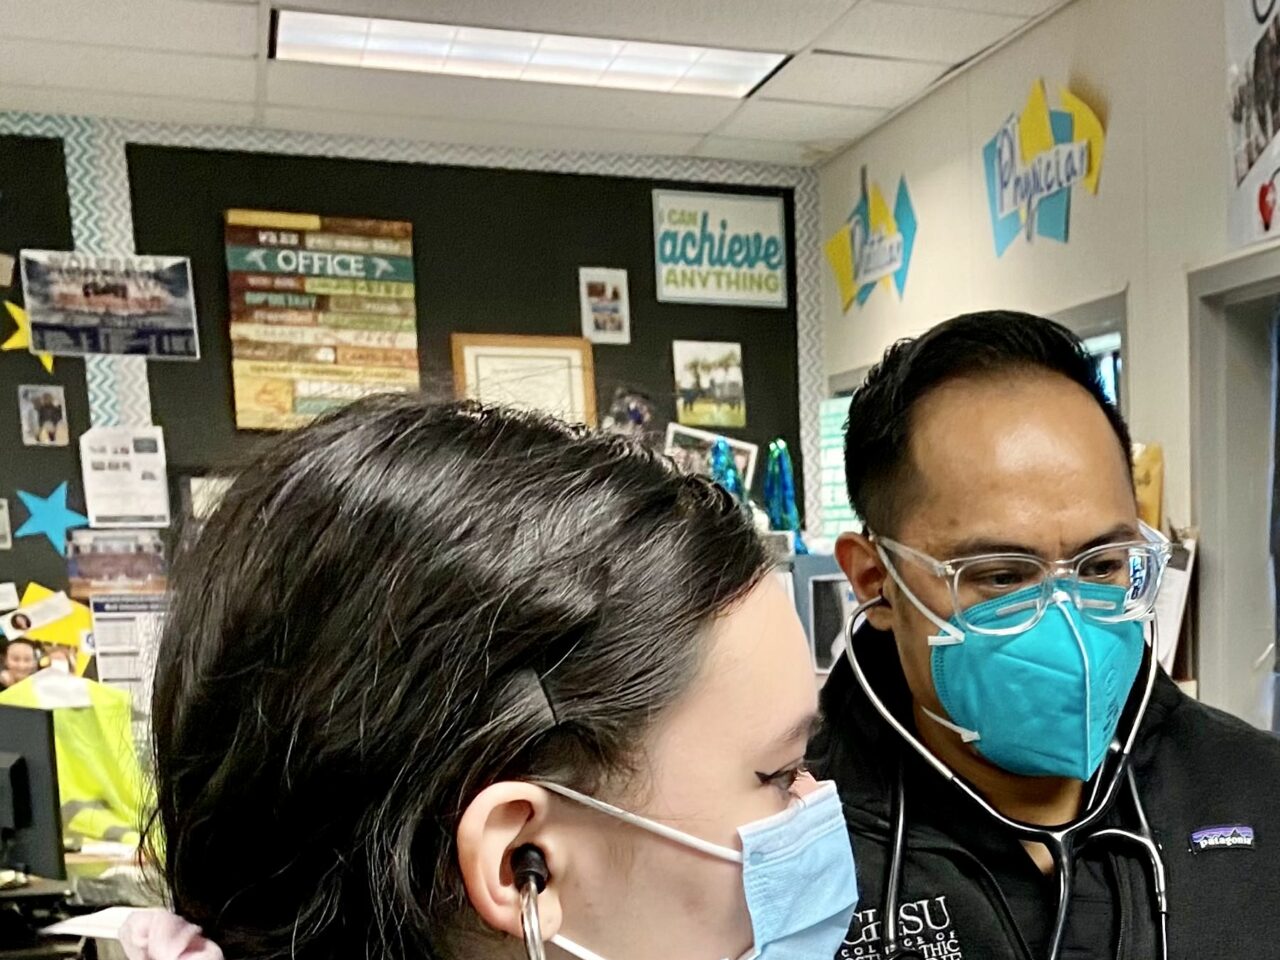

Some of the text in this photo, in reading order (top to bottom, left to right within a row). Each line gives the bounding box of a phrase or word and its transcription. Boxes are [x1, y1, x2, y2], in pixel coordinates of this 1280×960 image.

[667, 208, 698, 226] CAN
[659, 210, 784, 271] achieve
[277, 249, 366, 276] OFFICE
[665, 268, 780, 293] ANYTHING
[1200, 836, 1252, 849] patagonia
